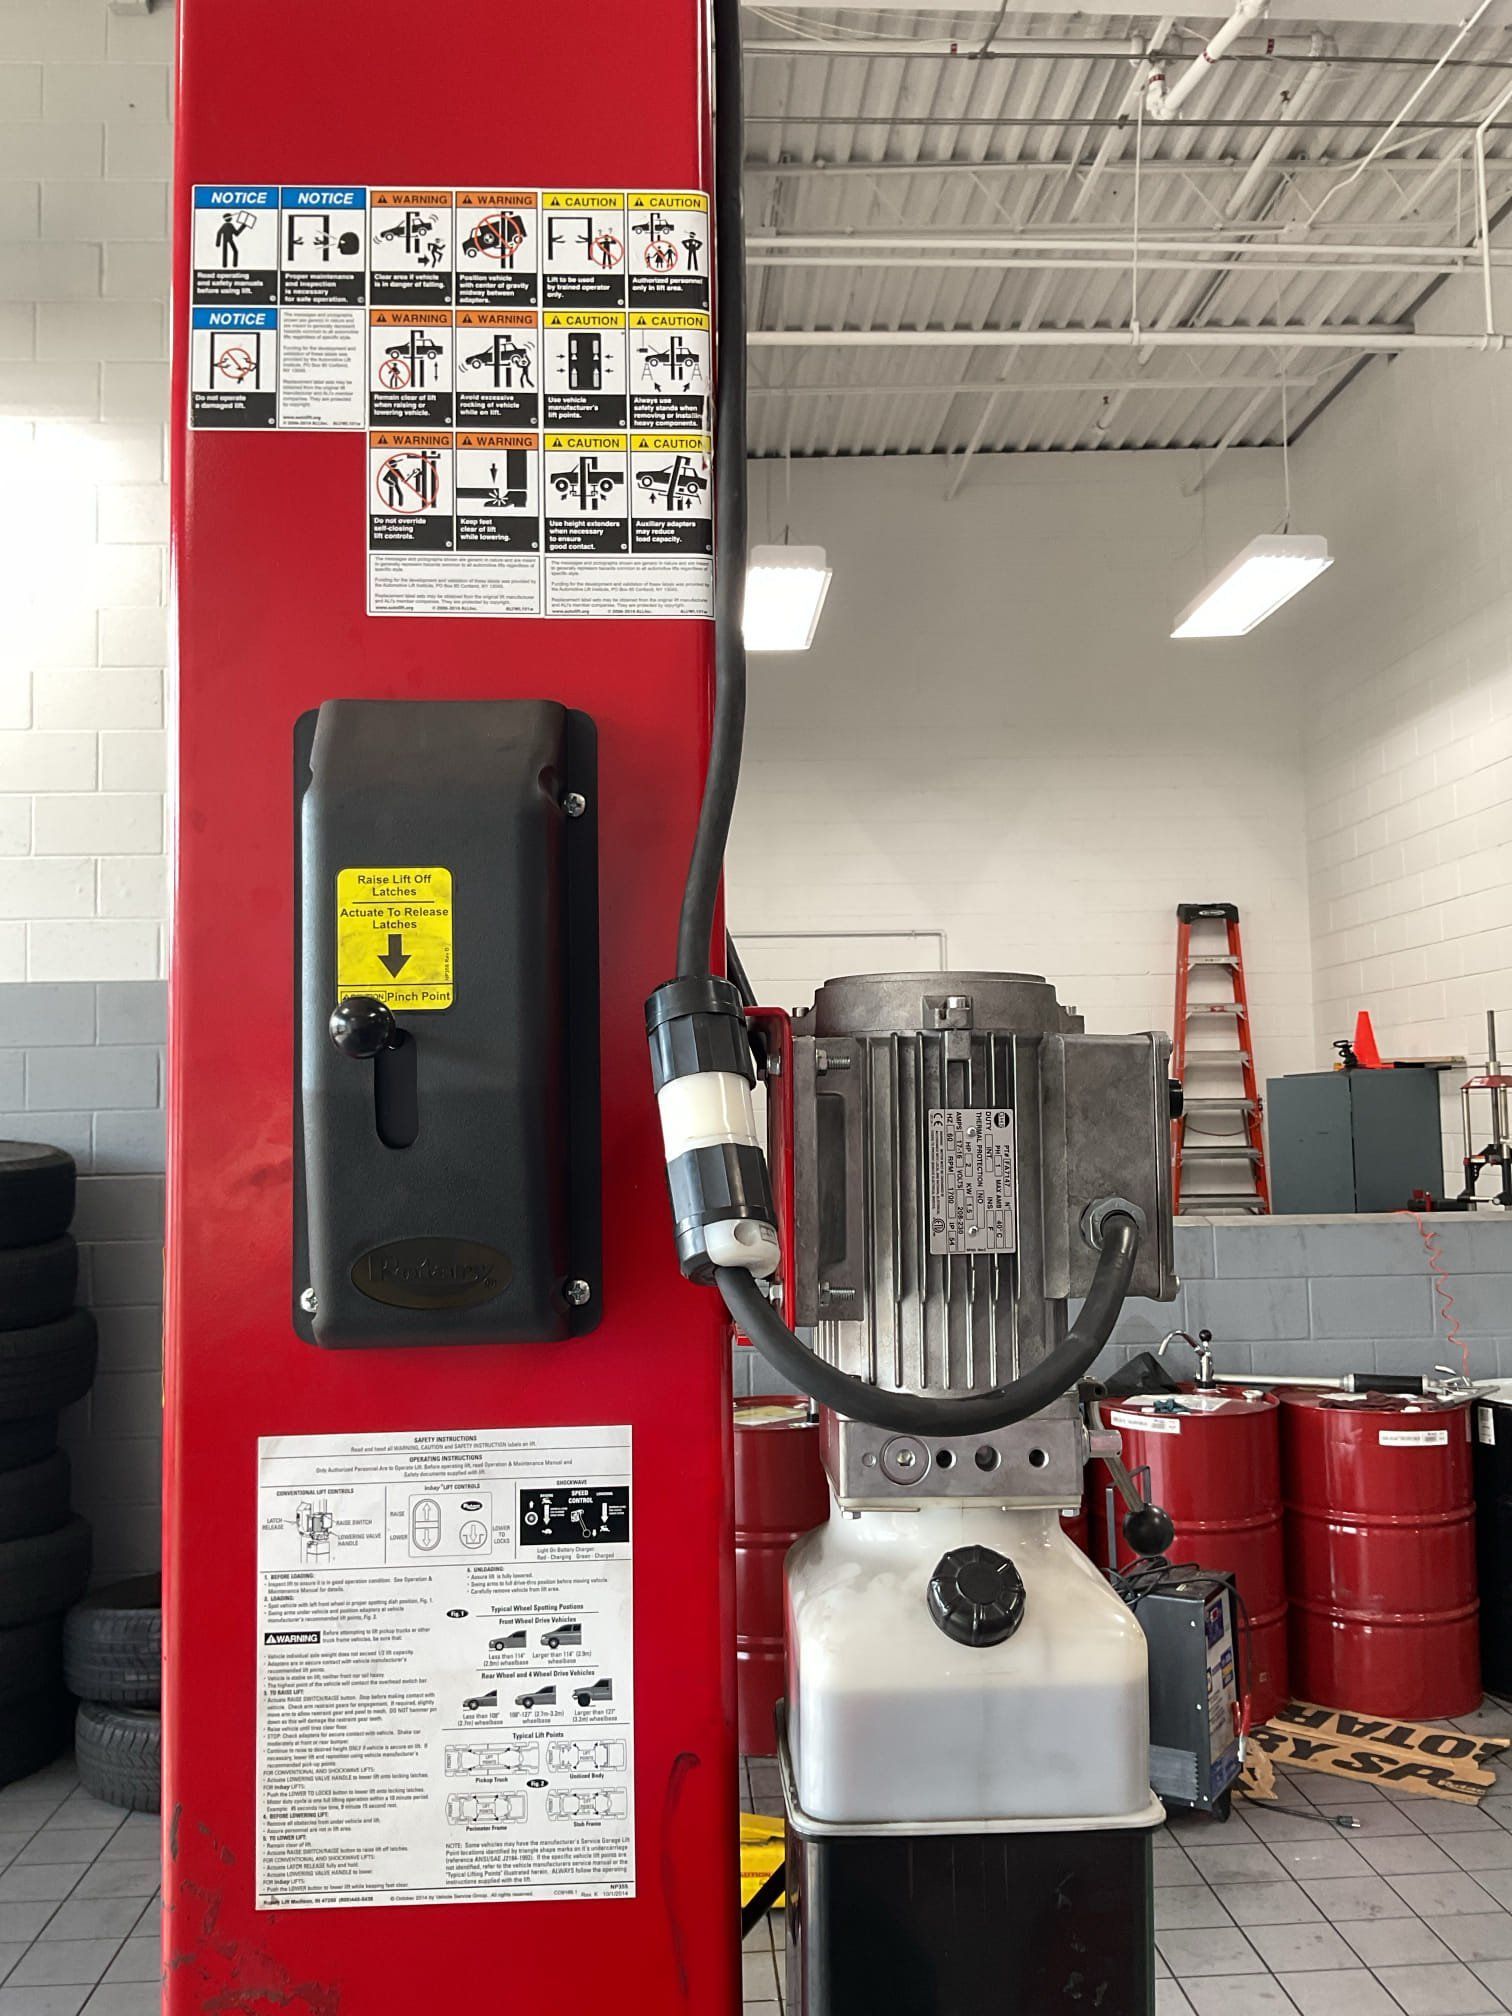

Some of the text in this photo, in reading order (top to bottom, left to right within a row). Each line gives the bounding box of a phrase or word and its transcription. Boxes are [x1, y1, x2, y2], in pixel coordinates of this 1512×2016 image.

[211, 192, 267, 203] NOTICE
[298, 193, 354, 204] NOTICE
[393, 195, 447, 204] WARNING
[478, 196, 532, 205] WARNING
[565, 198, 616, 207] CAUTION
[650, 198, 701, 208] CAUTION
[210, 313, 265, 325] NOTICE
[392, 314, 447, 323] WARNING
[478, 315, 533, 324] WARNING
[566, 316, 618, 326] CAUTION
[652, 317, 703, 326] CAUTION
[393, 436, 449, 445] WARNING
[477, 437, 532, 447] WARNING
[568, 438, 620, 448] CAUTION
[460, 533, 510, 541] while lowering.
[358, 875, 431, 884] Raise Lift Off
[372, 887, 416, 896] Latches
[340, 908, 448, 917] Actuate To Release
[373, 920, 417, 928] Latches
[387, 992, 418, 1000] Pinch
[422, 992, 450, 1000] Point
[934, 1113, 942, 1127] CE
[947, 1114, 952, 1123] HZ
[966, 1142, 970, 1152] HP
[995, 1146, 1001, 1154] PH
[966, 1183, 971, 1194] KW
[978, 1193, 983, 1204] NO
[414, 1435, 477, 1444] SAFETY INSTRUCTIONS
[410, 1454, 482, 1463] OPERATING INSTRUCTIONS
[317, 1488, 326, 1496] LIFT
[328, 1488, 354, 1496] CONTROLS
[491, 1604, 512, 1614] Typical
[513, 1604, 533, 1613] Wheel
[533, 1603, 558, 1613] Spotting
[276, 1634, 318, 1642] WARNING
[482, 1671, 495, 1680] Rear
[496, 1671, 515, 1679] Wheel
[516, 1670, 528, 1679] and
[533, 1670, 552, 1679] Wheel
[554, 1670, 568, 1678] Drive
[570, 1669, 595, 1678] Vehicles
